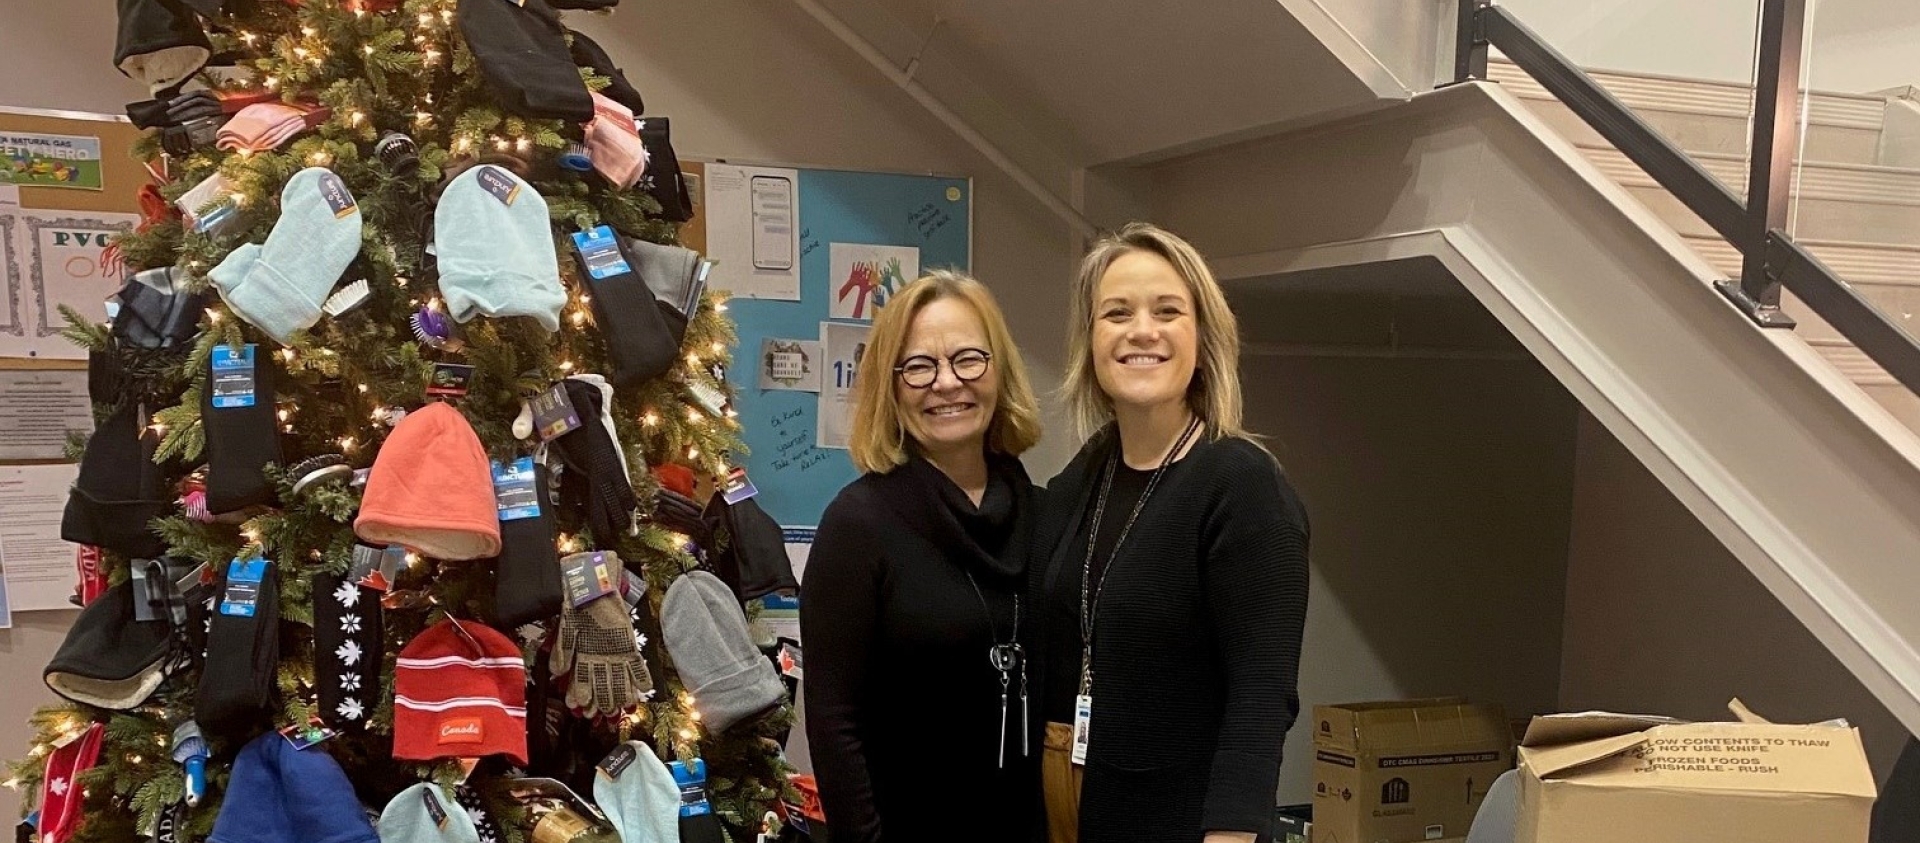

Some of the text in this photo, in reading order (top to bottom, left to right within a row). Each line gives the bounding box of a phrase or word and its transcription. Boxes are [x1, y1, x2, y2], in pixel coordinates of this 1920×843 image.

[11, 137, 50, 146] NATURAL
[53, 140, 72, 148] GAS
[43, 146, 89, 160] HERO
[442, 722, 480, 737] Canada
[1683, 738, 1760, 746] CONTENTS
[1764, 738, 1784, 746] TO
[1788, 739, 1830, 747] THAW
[1648, 757, 1761, 766] FROZEN FOODS
[1738, 765, 1779, 773] RUSH
